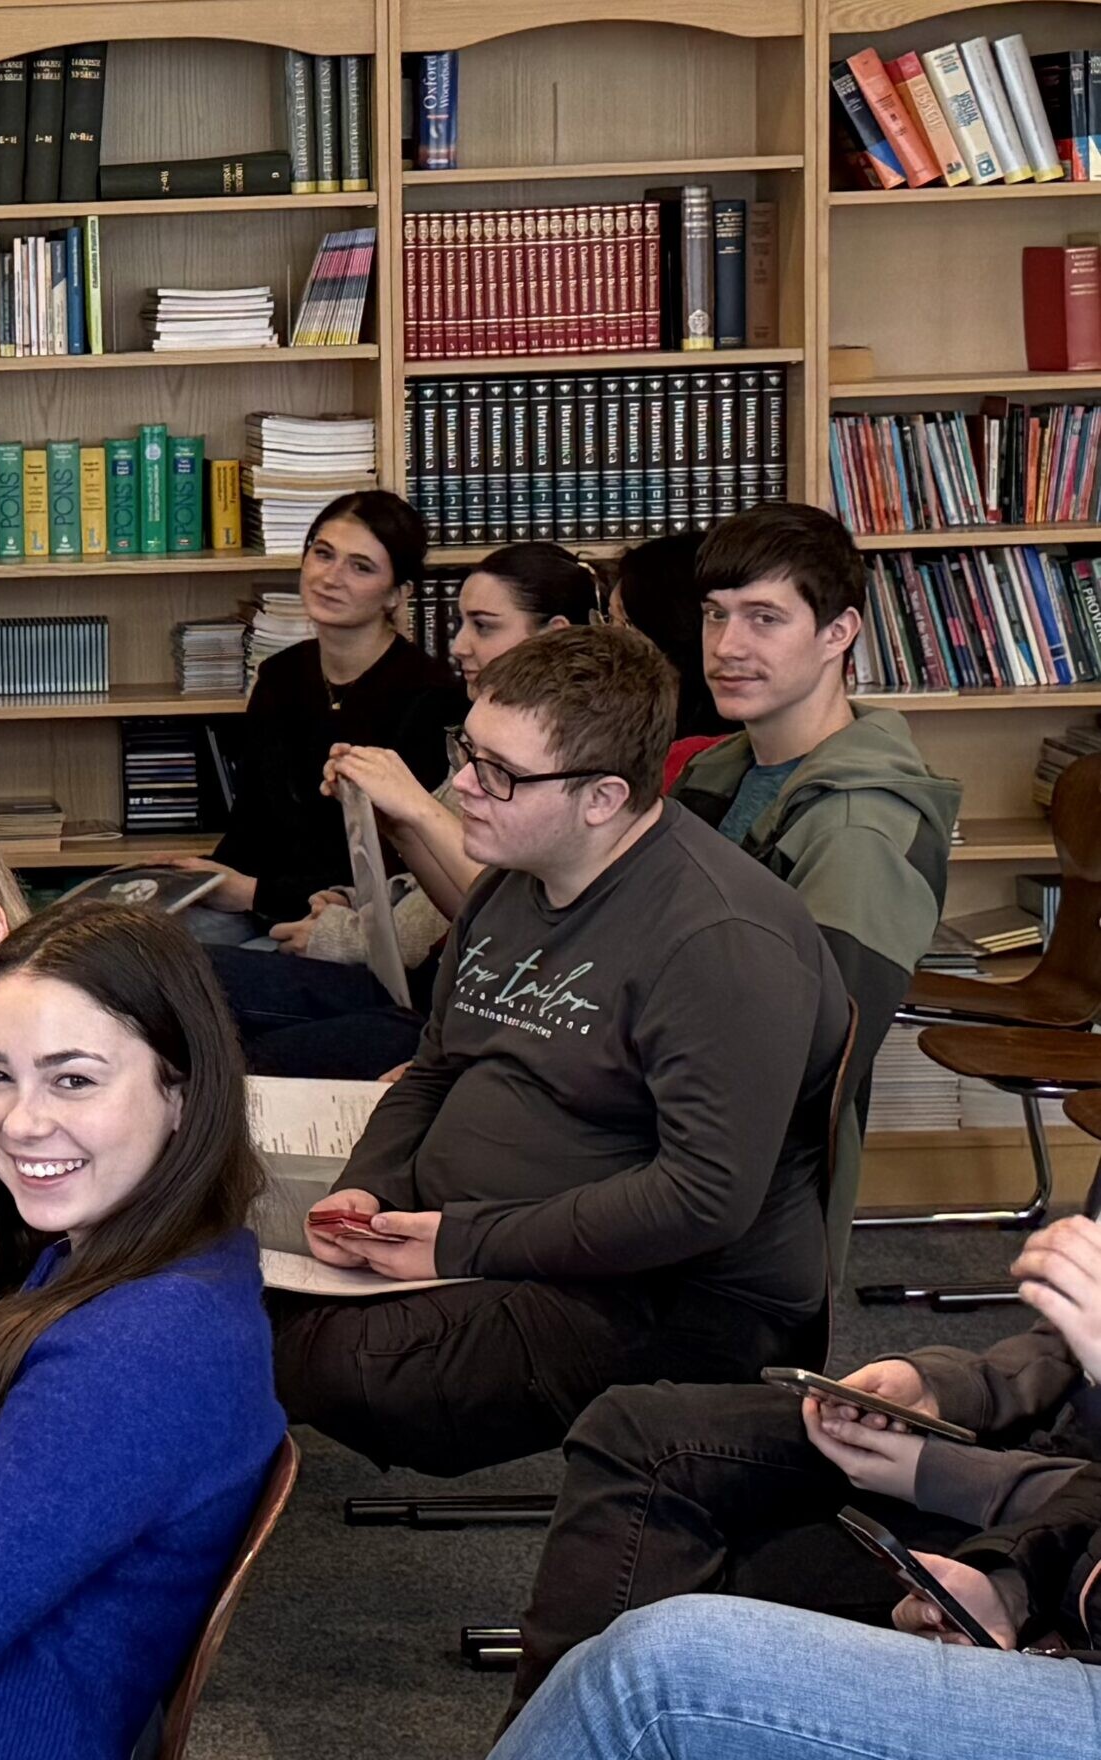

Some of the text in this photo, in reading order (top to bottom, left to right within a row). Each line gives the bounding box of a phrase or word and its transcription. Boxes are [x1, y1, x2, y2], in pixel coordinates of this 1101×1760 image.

[423, 55, 437, 109] Oxford
[295, 60, 308, 173] EUROPA AETERNA
[424, 410, 435, 469] Britannica
[447, 409, 457, 468] Britannica
[470, 408, 480, 467] Britannica
[492, 407, 503, 467] Britannica
[514, 407, 525, 466] Britannica
[537, 406, 548, 465] Britannica
[561, 405, 572, 465] Britannica
[585, 404, 595, 464] Britannica
[608, 403, 619, 463] Britannica
[629, 403, 640, 462] Britannica
[651, 402, 662, 462] Britannica
[674, 401, 685, 460] Britannica
[698, 400, 708, 459] Britannica
[722, 399, 732, 459] Britannica
[746, 398, 757, 458] Britannica
[770, 397, 781, 457] Britannica
[1, 472, 20, 528] PONS
[54, 469, 74, 526] PONS
[114, 483, 133, 536] PONS
[175, 481, 194, 535] PONS
[224, 528, 237, 545] L
